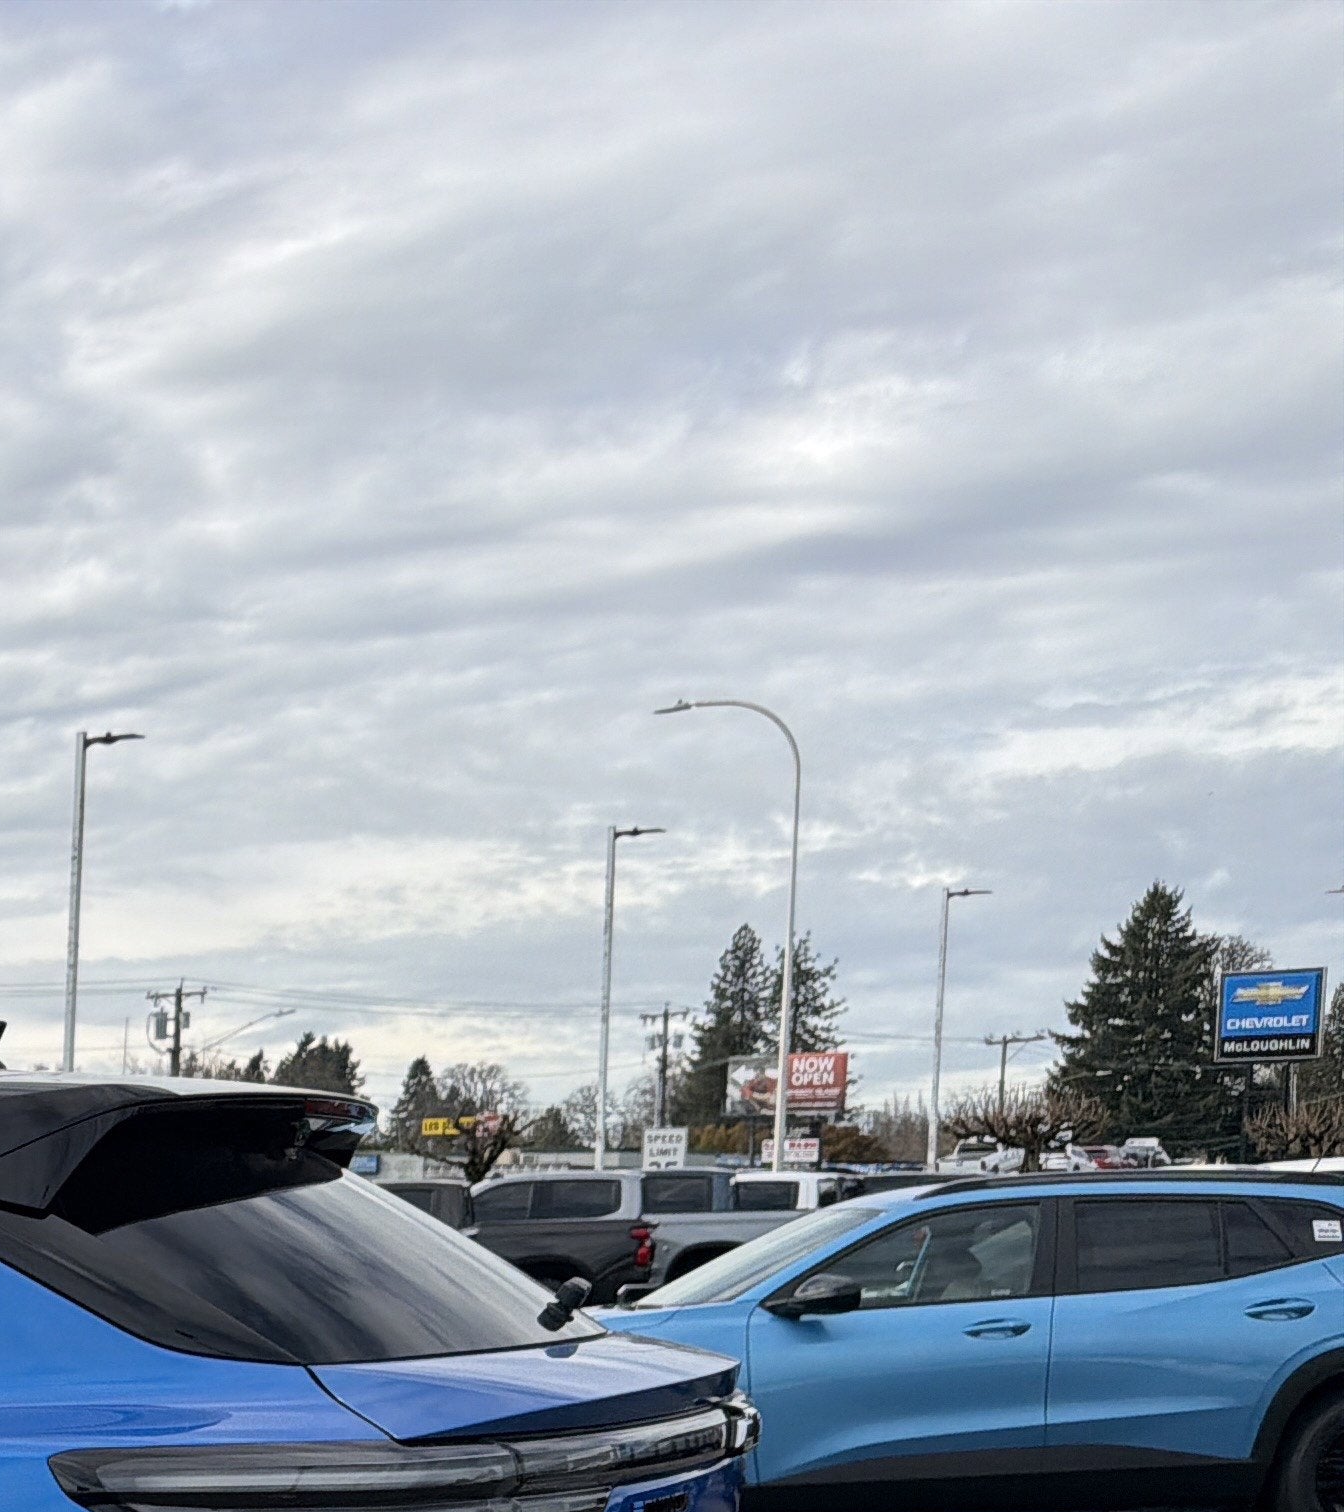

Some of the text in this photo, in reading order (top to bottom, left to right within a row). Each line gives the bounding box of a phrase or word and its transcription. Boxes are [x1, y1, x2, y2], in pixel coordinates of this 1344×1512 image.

[1226, 1014, 1309, 1030] CHEVROLET
[1223, 1038, 1310, 1052] McLOUGHLIN
[792, 1056, 835, 1073] NOW
[791, 1072, 835, 1086] OPEN
[647, 1134, 683, 1144] SPEED
[649, 1147, 678, 1157] LIMIT
